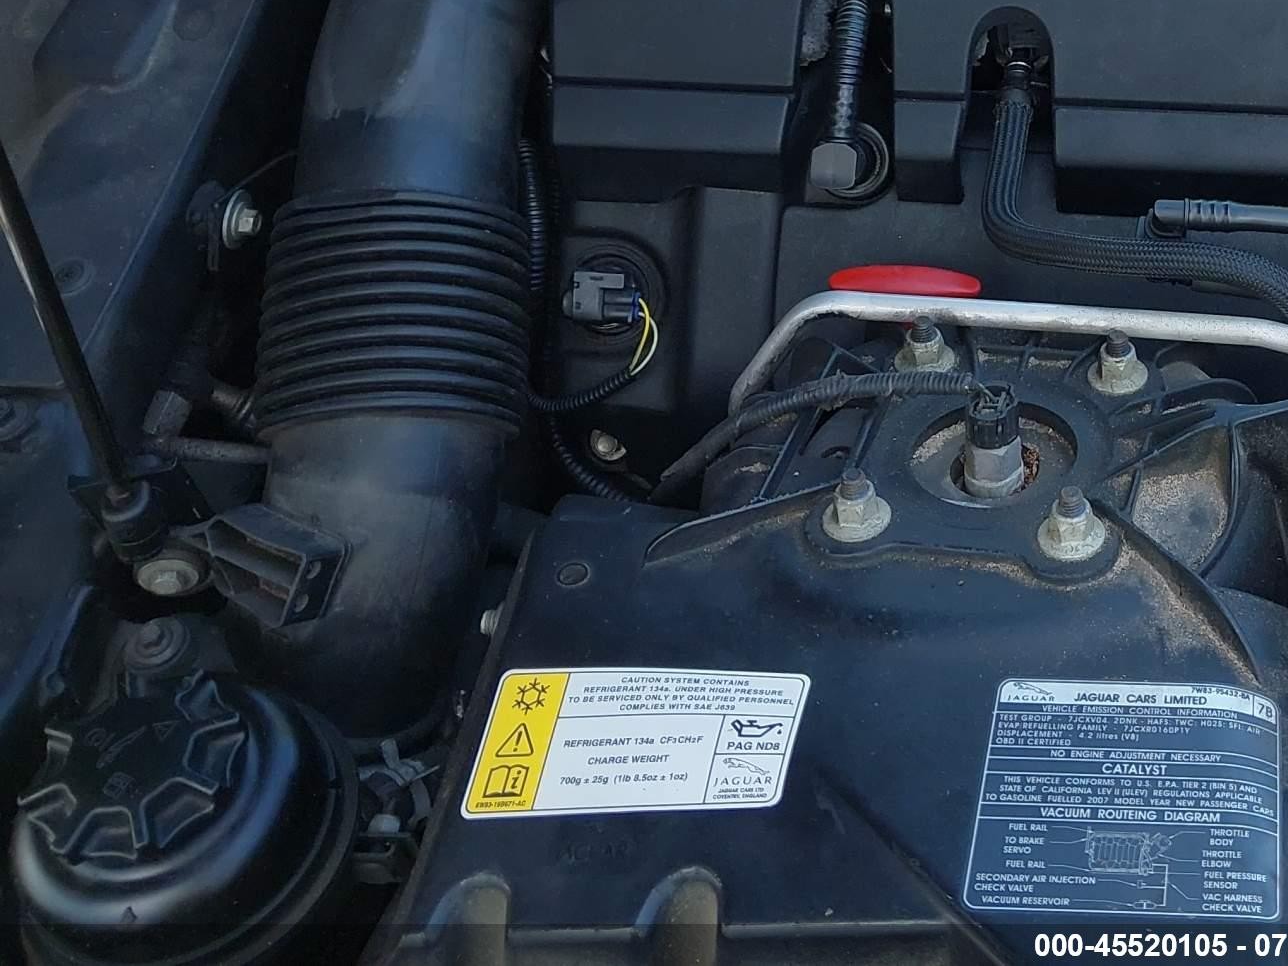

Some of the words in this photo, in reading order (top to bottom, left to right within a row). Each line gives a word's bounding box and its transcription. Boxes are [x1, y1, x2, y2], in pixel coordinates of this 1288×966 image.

[704, 678, 749, 686] CONTAINS
[584, 685, 646, 693] REFRIGERANT
[738, 696, 794, 705] PERSONNEL
[1007, 694, 1055, 702] JAGUAR
[1073, 693, 1120, 703] JAGUAR
[1126, 694, 1157, 704] CARS
[1164, 695, 1207, 706] LIMITED
[620, 703, 665, 711] COMPLIES
[1257, 703, 1273, 718] 7B
[1042, 705, 1077, 713] VEHICLE
[1082, 706, 1124, 714] EMISSION
[1129, 707, 1171, 715] CONTROL
[1177, 709, 1238, 719] INFORMATION
[998, 721, 1019, 729] EVAP
[1022, 722, 1074, 730] REFUELLING
[1246, 726, 1261, 734] AIR
[996, 737, 1015, 745] OBD
[1027, 738, 1071, 746] CERTIFIED
[1121, 733, 1139, 741] (V8)
[564, 738, 631, 748] REFRIGERANT
[634, 737, 655, 745] 134a
[727, 741, 753, 751] PAG
[756, 742, 781, 751] ND8
[587, 755, 629, 765] CHARGE
[632, 754, 670, 763] WEIGHT
[1070, 750, 1104, 758] ENGINE
[1109, 751, 1165, 760] ADJUSTMENT
[1170, 753, 1221, 762] NECESSARY
[1102, 763, 1167, 775] CATALYST
[560, 776, 581, 786] 700g
[592, 775, 609, 785] 25g
[713, 776, 772, 787] JAGUAR
[1004, 775, 1021, 783] THIS
[1026, 776, 1060, 784] VEHICLE
[1065, 777, 1115, 786] CONFORMS
[1182, 781, 1199, 789] TIER
[1201, 781, 1207, 789] 2
[1240, 784, 1258, 794] AND
[1024, 785, 1036, 793] OF
[1041, 786, 1092, 794] CALIFORNIA
[1098, 787, 1112, 795] LEV
[1121, 788, 1148, 797] (ULEV)
[1153, 789, 1210, 798] REGULATIONS
[1214, 792, 1263, 804] APPLICABLE
[999, 794, 1042, 802] GASOLINE
[1047, 795, 1082, 803] FUELLED
[1087, 796, 1109, 804] 2007
[1114, 797, 1144, 806] MODEL
[1150, 798, 1171, 806] YEAR
[1175, 799, 1195, 807] NEW
[1200, 800, 1248, 810] PASSENGER
[1252, 805, 1274, 817] CARS
[1040, 807, 1091, 818] VACUUM
[1097, 809, 1157, 821] ROUTEING
[1164, 811, 1221, 822] DIAGRAM
[1008, 823, 1027, 831] FUEL
[1209, 829, 1250, 838] THROTTLE
[1004, 836, 1017, 844] TO
[1019, 837, 1044, 845] BRAKE
[1209, 838, 1234, 846] BODY
[1003, 846, 1032, 854] SERVO
[1202, 850, 1242, 859] THROTTLE
[1006, 860, 1025, 868] FUEL
[1027, 860, 1047, 869] RAIL
[1201, 860, 1232, 868] ELBOW
[975, 873, 1029, 882] SECONDARY
[1031, 875, 1047, 883] AIR
[1049, 876, 1096, 884] INJECTION
[1204, 871, 1224, 879] FUEL
[1226, 872, 1267, 882] PRESSURE
[974, 883, 1006, 891] CHECK
[1008, 884, 1034, 892] VALVE
[1203, 881, 1238, 889] SENSOR
[981, 895, 1019, 904] VACUUM
[1022, 897, 1070, 906] RESERVOIR
[1202, 893, 1221, 901] VAC
[1224, 894, 1263, 903] HARNESS
[1202, 903, 1234, 912] CHECK
[1236, 905, 1262, 913] VALVE
